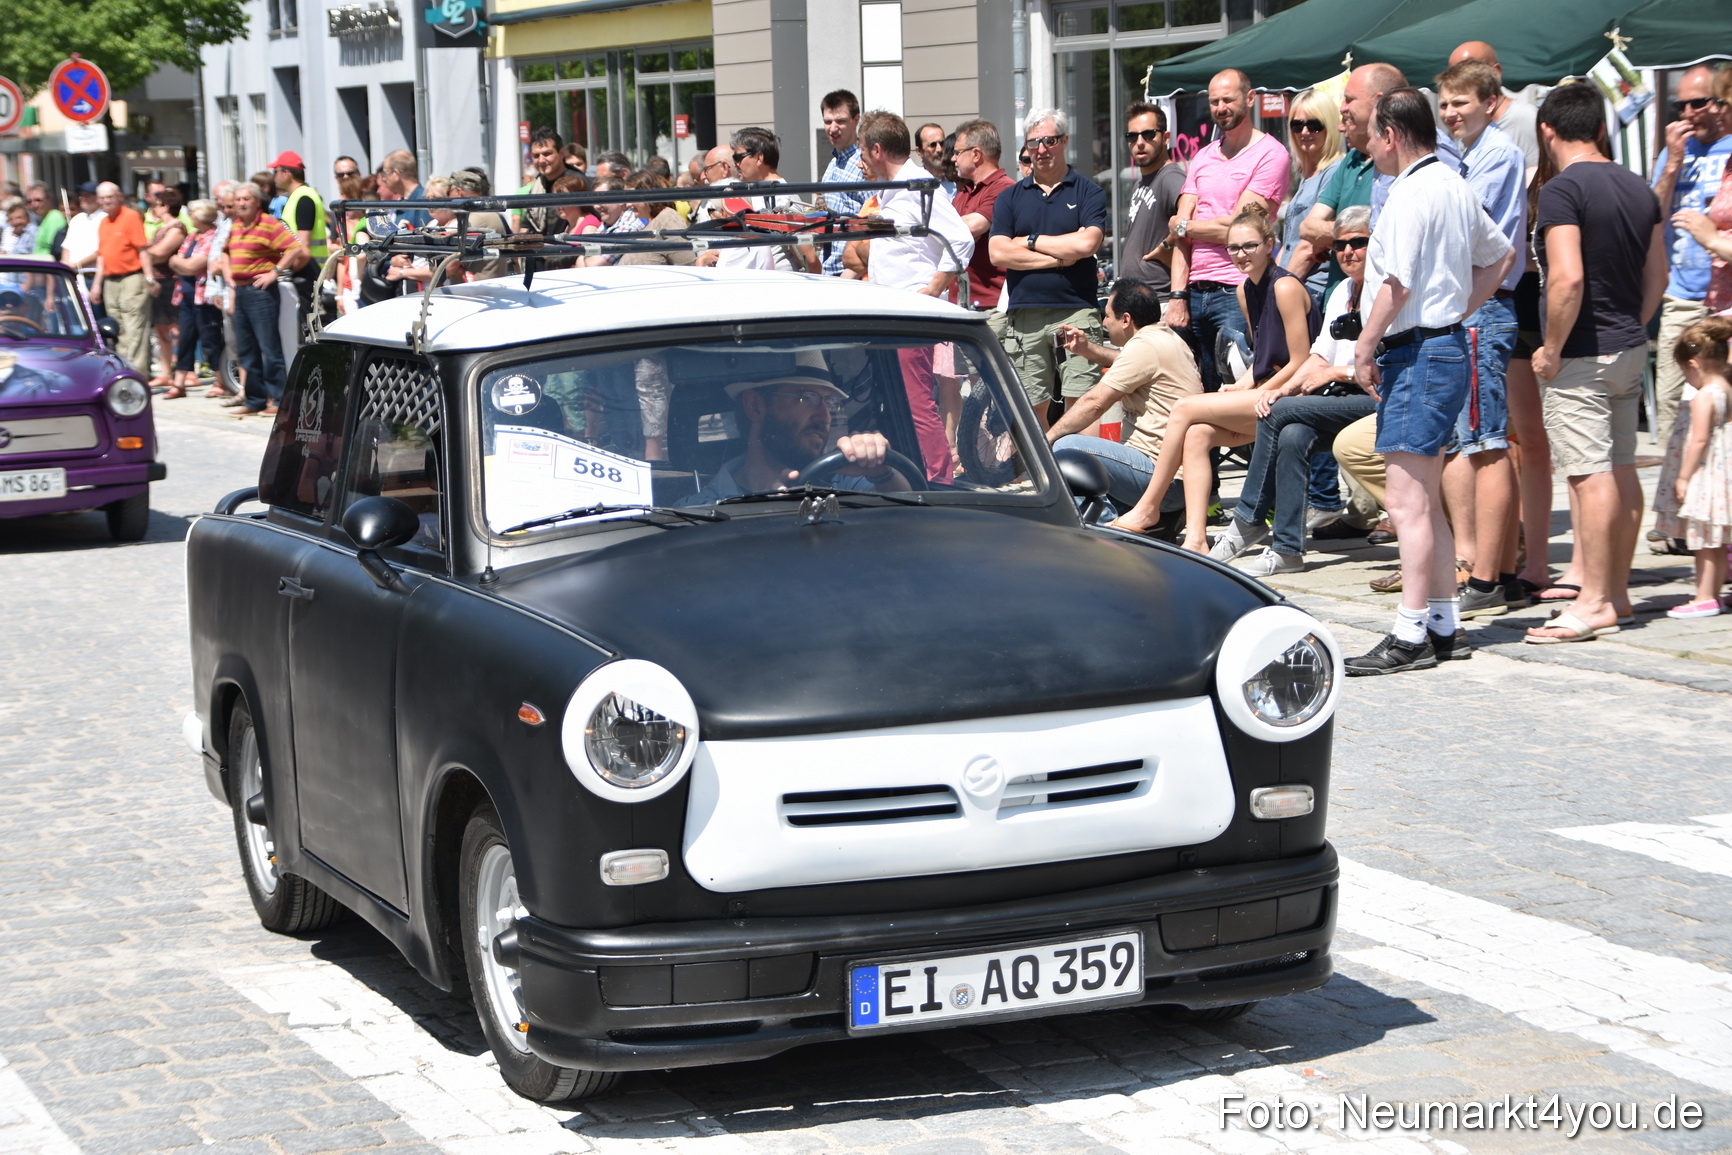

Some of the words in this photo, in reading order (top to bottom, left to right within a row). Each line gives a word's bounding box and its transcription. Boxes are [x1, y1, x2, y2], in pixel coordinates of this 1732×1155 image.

[573, 456, 622, 483] 588
[30, 474, 49, 492] 86
[884, 966, 943, 1016] EI
[981, 955, 1040, 1005] AQ
[1052, 941, 1135, 995] 359
[860, 1002, 871, 1015] D
